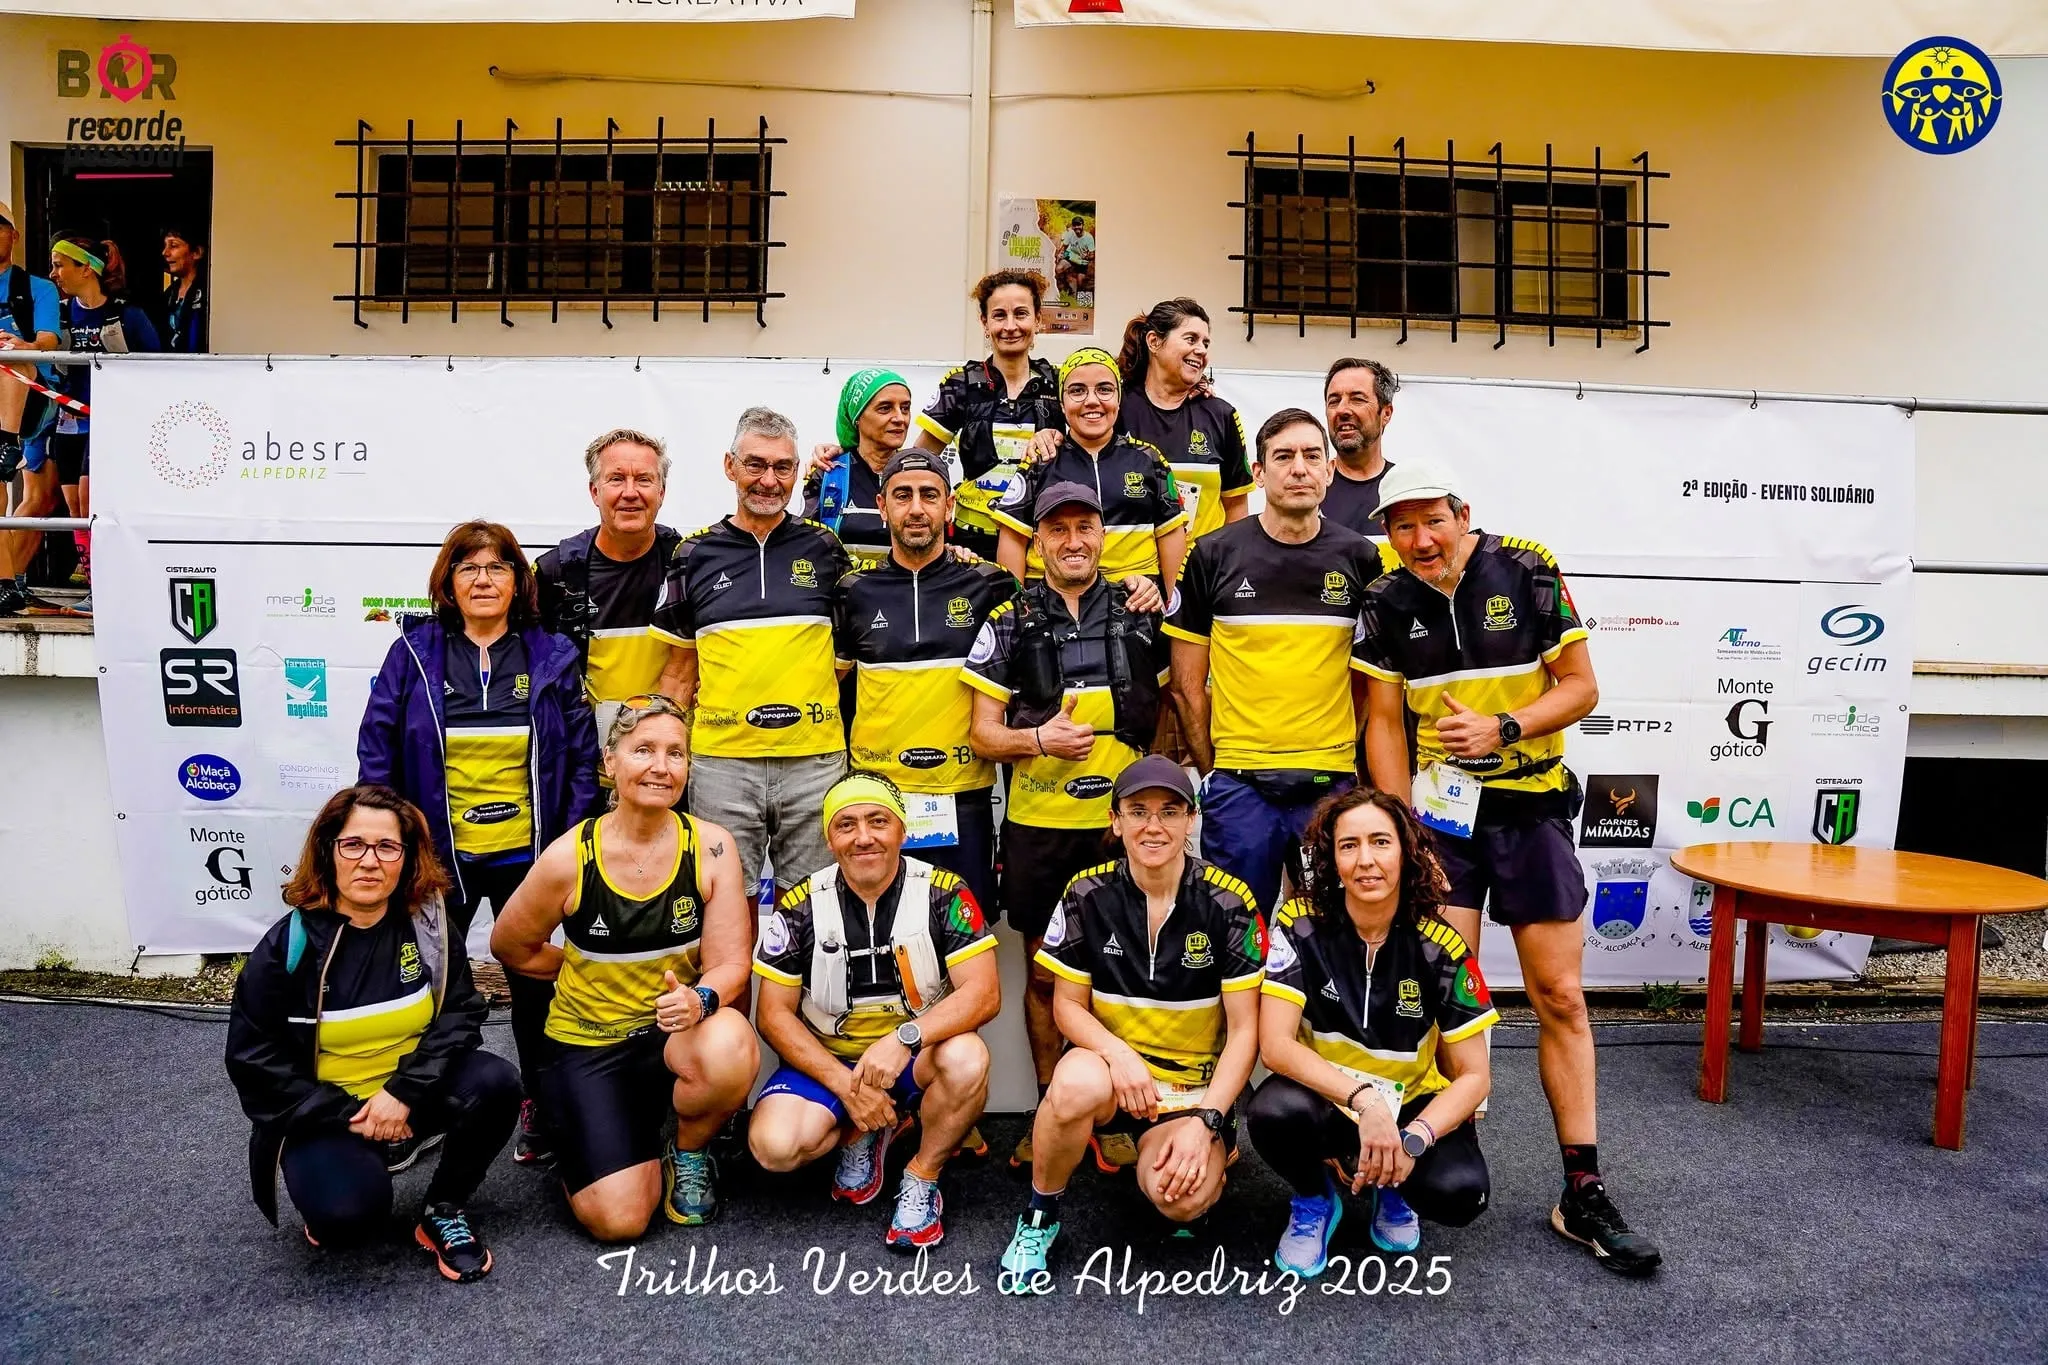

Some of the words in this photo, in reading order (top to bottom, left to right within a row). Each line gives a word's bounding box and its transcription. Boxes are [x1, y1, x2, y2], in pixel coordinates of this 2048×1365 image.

[58, 49, 177, 100] BAR
[241, 431, 368, 461] abesra
[240, 467, 328, 480] ALPEDRIZ
[1682, 479, 1699, 498] 2ª
[1703, 479, 1748, 503] EDIÇÃO
[1760, 483, 1807, 501] EVENTO
[1810, 483, 1875, 504] SOLIDÁRIO
[165, 566, 217, 574] CISTERAUTO
[712, 581, 733, 591] SELECT
[266, 588, 336, 607] medida
[1234, 591, 1257, 599] SELECT
[870, 622, 889, 630] SELECT
[1409, 629, 1429, 640] SELECT
[285, 659, 325, 669] farmácia
[1806, 653, 1887, 675] gecim
[164, 658, 236, 696] SR
[1717, 678, 1774, 694] Monte
[168, 703, 238, 717] Informática
[287, 702, 328, 719] magalhães
[1812, 705, 1881, 726] medida
[1616, 719, 1661, 733] RTP
[1664, 721, 1673, 733] 2
[1724, 698, 1775, 751] G
[1709, 741, 1764, 761] gótico
[200, 764, 231, 780] Maçã
[185, 777, 237, 793] Alcobaça
[1447, 784, 1460, 798] 43
[924, 802, 938, 813] 38
[1728, 797, 1775, 828] CA
[1599, 818, 1639, 827] CARNES
[190, 827, 246, 843] Monte
[1584, 824, 1650, 838] MIMADAS
[204, 846, 253, 894] G
[195, 885, 251, 905] gótico
[588, 928, 610, 937] SELECT
[1103, 946, 1124, 957] SELECT
[1320, 989, 1340, 1003] SELECT
